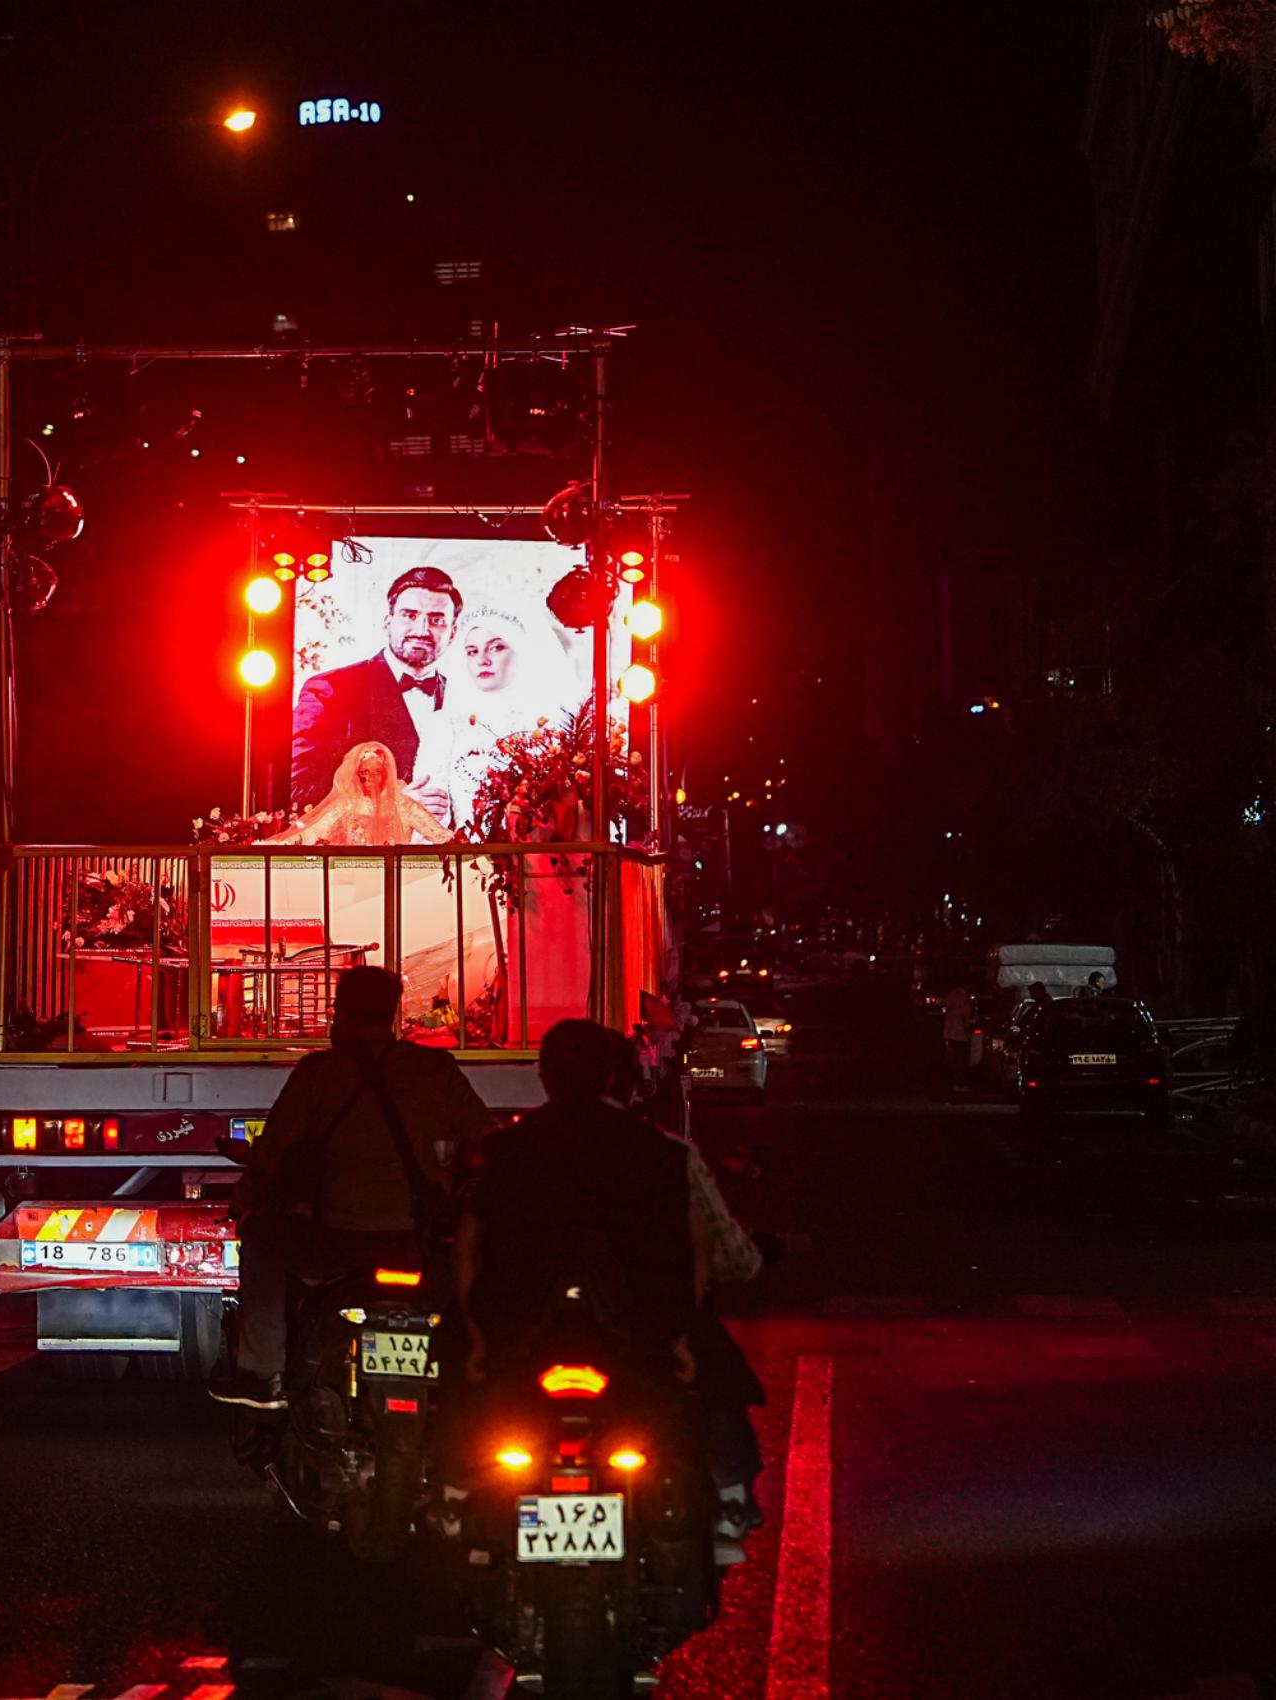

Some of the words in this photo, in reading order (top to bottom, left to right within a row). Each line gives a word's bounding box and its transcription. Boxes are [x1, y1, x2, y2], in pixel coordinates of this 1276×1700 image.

[39, 1245, 65, 1260] 18
[87, 1246, 127, 1262] 786
[556, 1502, 606, 1523] ۱۶۵
